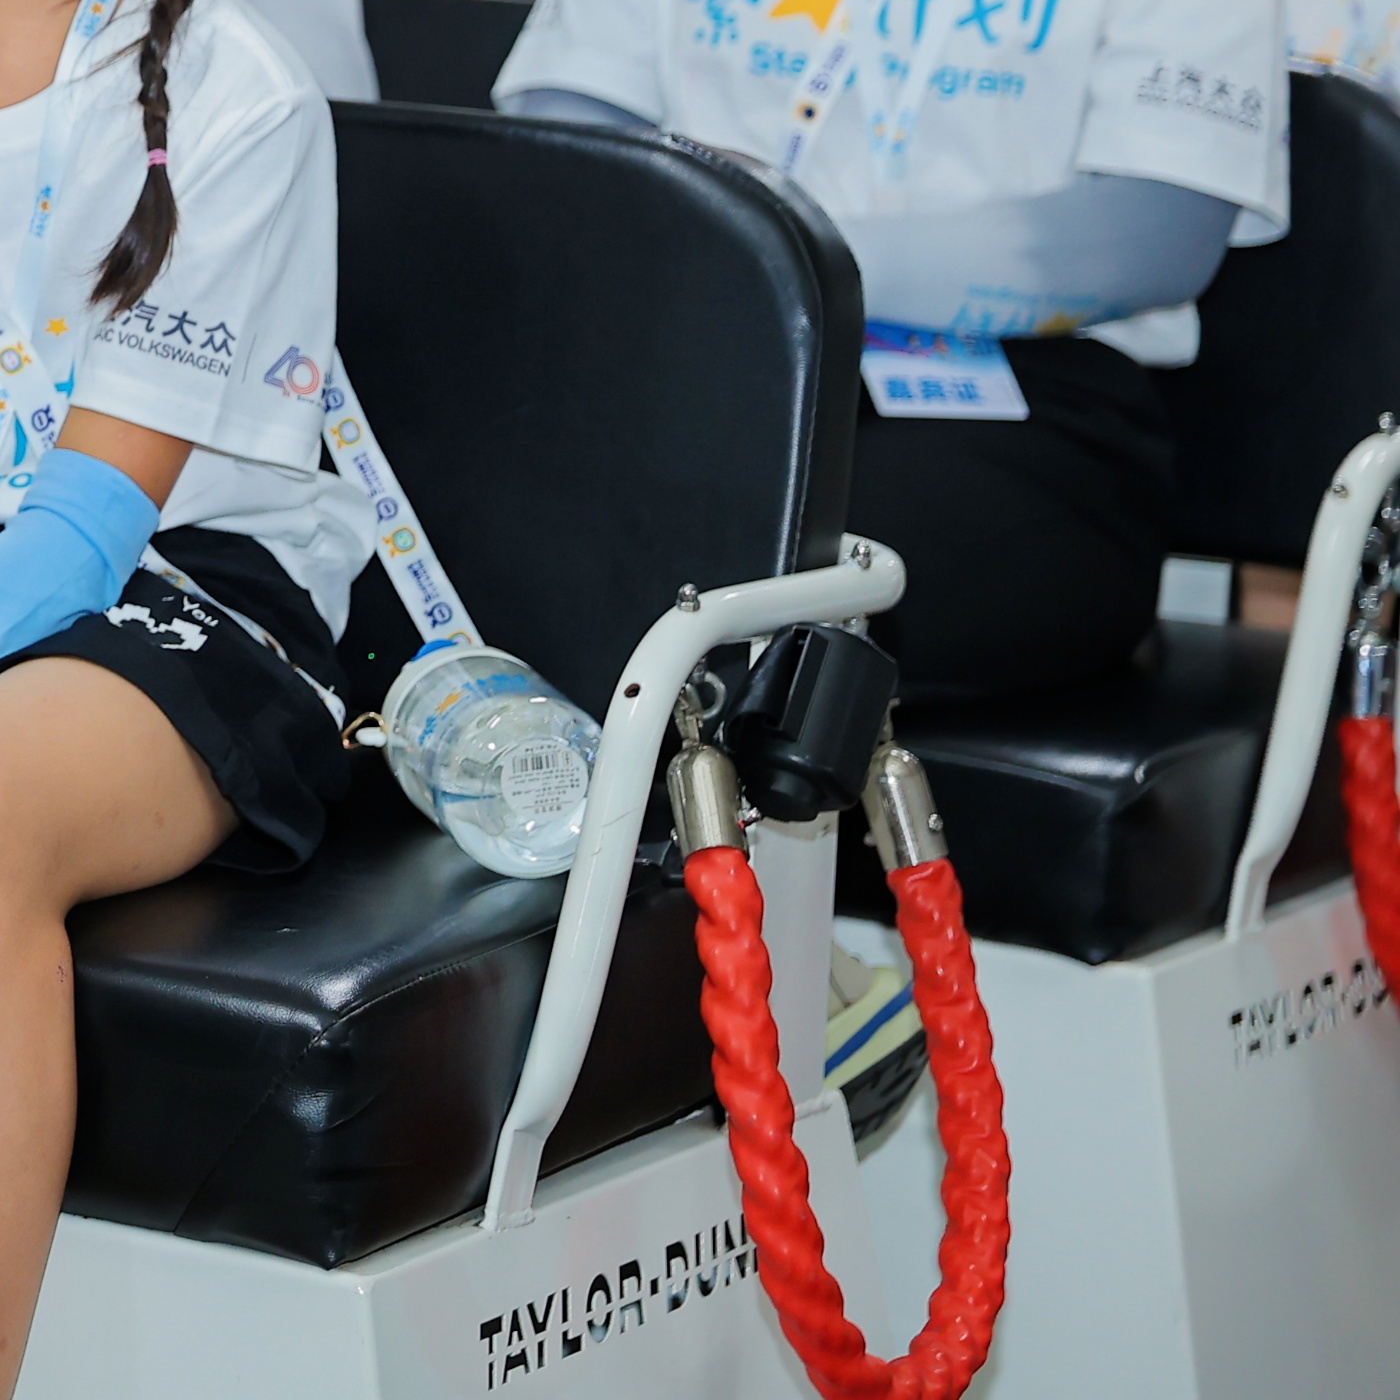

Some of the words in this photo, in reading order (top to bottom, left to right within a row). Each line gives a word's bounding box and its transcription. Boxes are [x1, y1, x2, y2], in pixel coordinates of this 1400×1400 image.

[110, 300, 237, 357] 汽大众
[117, 328, 232, 378] VOLKSWAGEN
